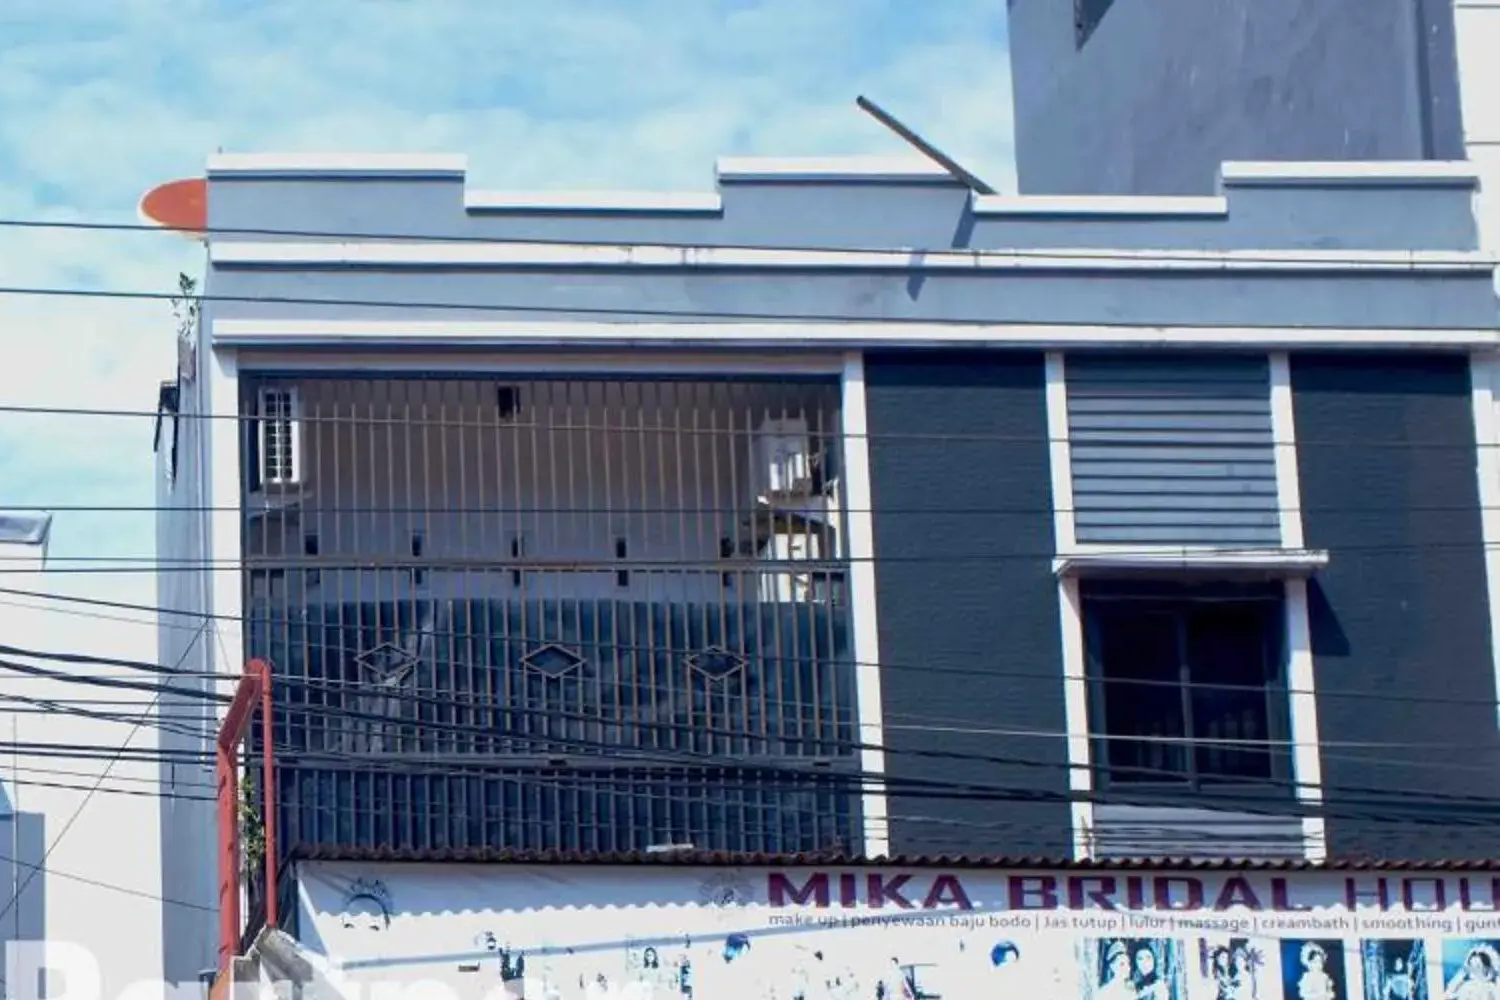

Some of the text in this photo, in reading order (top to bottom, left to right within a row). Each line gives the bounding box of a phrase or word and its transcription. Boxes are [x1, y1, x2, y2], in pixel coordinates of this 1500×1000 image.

[767, 872, 974, 909] MIKA
[1008, 875, 1313, 911] BRIDAL
[851, 914, 945, 930] penyewaan
[949, 914, 984, 930] baju
[990, 914, 1031, 928] bodo
[1073, 914, 1117, 931] tutup
[1178, 917, 1250, 932] massage
[1261, 914, 1349, 929] creambath
[1361, 914, 1453, 933] smoothing
